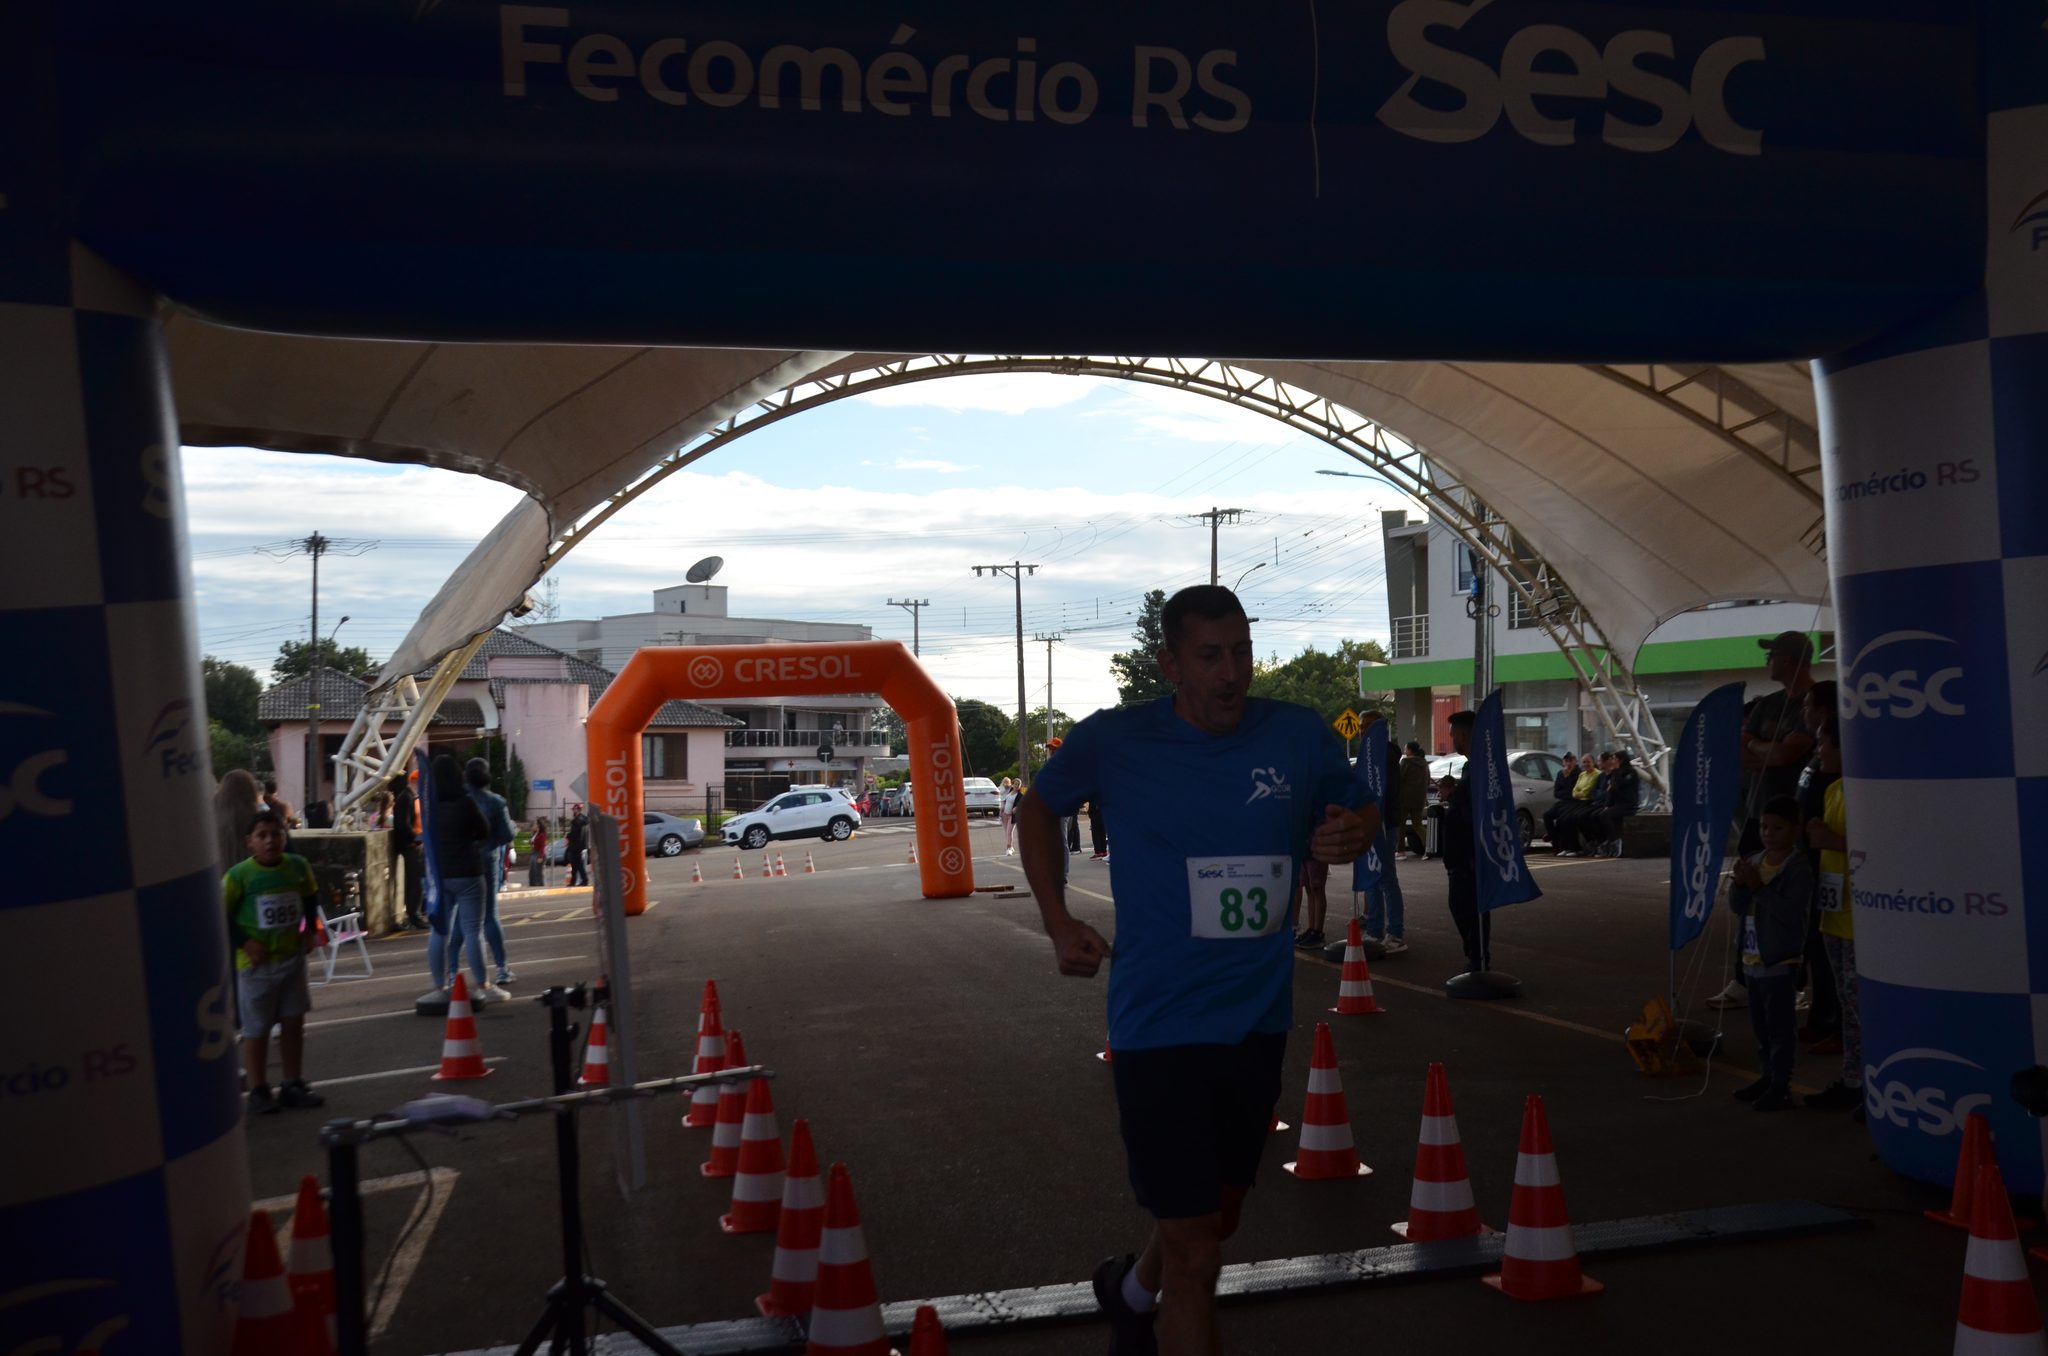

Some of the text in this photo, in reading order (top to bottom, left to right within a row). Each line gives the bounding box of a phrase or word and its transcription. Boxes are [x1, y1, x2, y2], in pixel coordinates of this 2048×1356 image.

[502, 8, 1252, 134] Fecomércio RS
[1376, 0, 1767, 156] Sesc
[17, 466, 74, 499] RS
[1937, 459, 1980, 486] RS
[734, 654, 862, 683] CRESOL
[931, 733, 958, 838] CRESOL
[1490, 808, 1520, 883] Sesc
[1685, 821, 1712, 922] Sesc
[1220, 887, 1269, 932] 83
[1965, 892, 2009, 916] RS
[83, 1043, 137, 1082] RS
